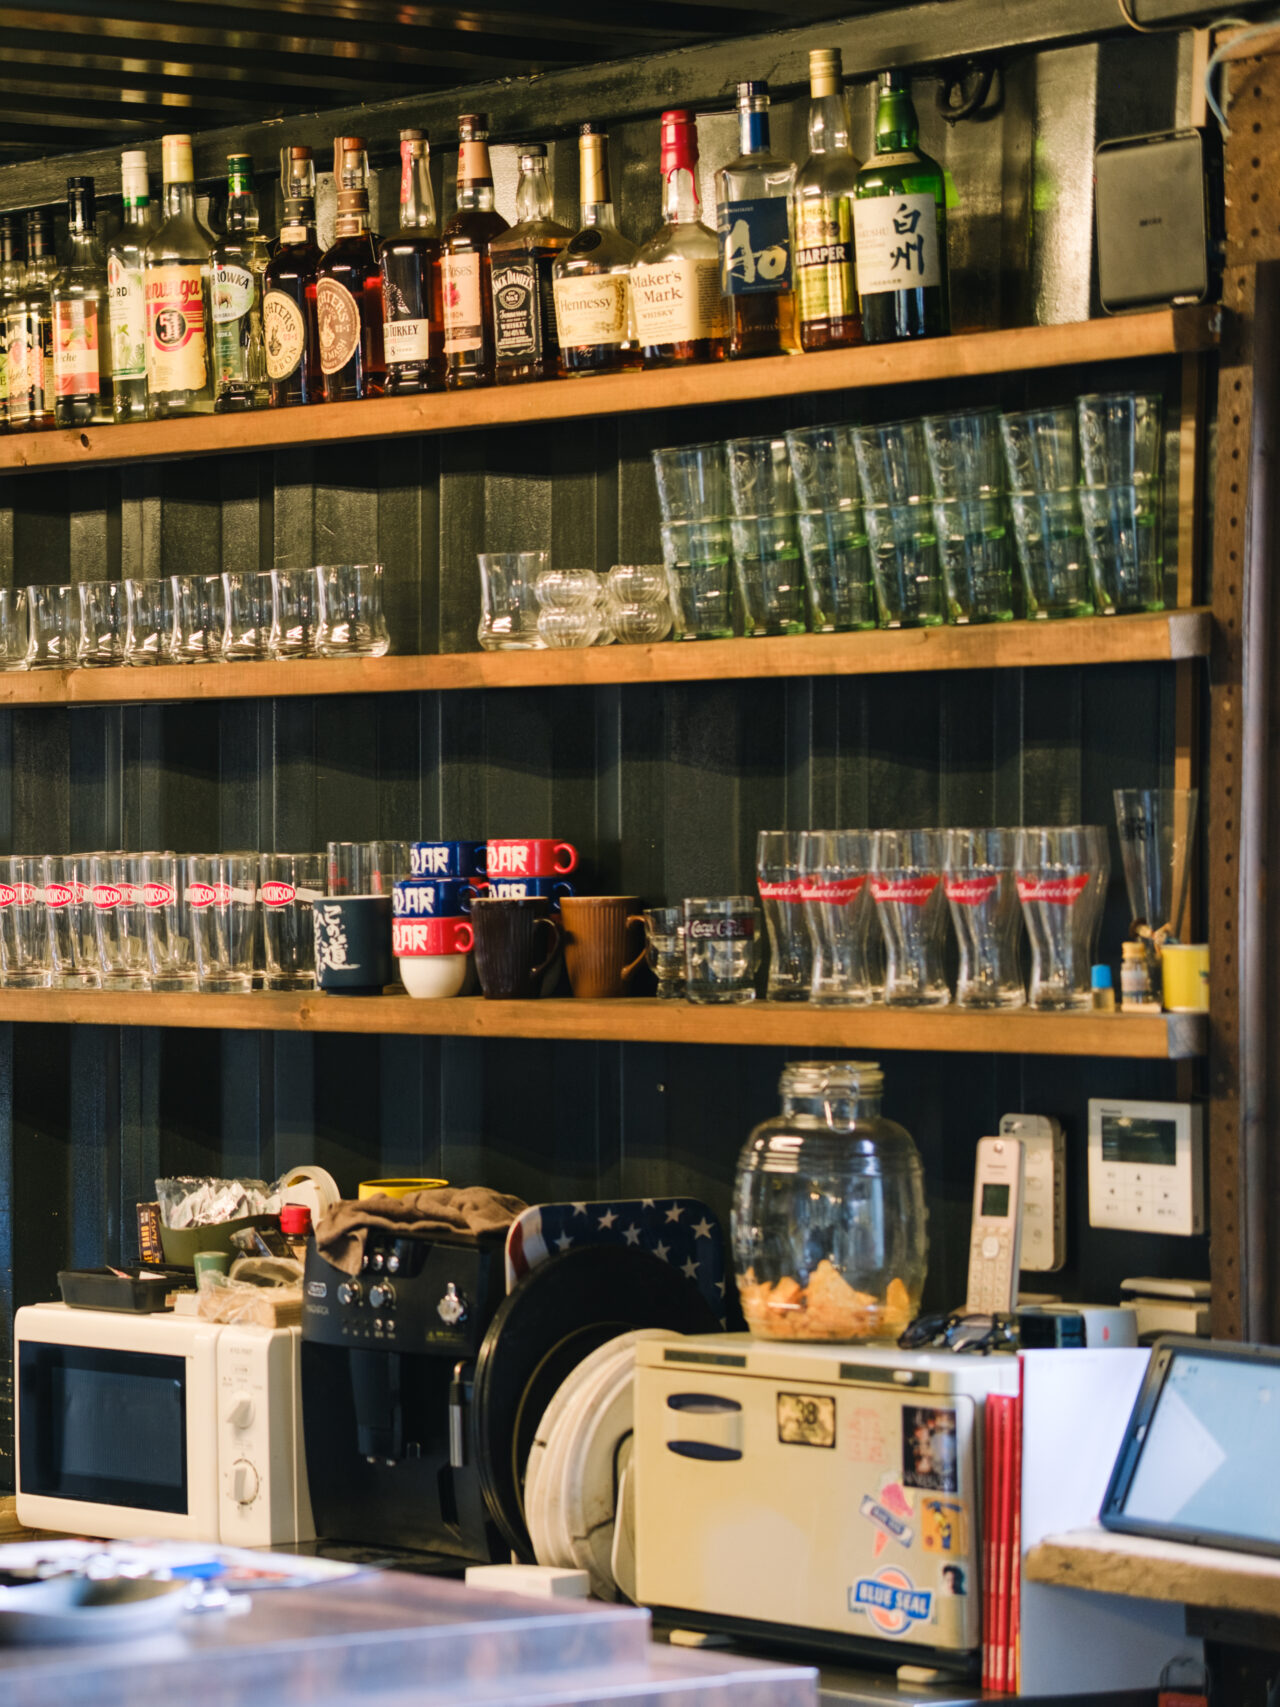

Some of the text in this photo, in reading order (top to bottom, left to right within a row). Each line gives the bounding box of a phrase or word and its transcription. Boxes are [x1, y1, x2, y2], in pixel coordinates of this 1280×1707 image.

[890, 203, 924, 275] 白州
[632, 270, 682, 289] Maker's
[644, 287, 683, 303] Mark
[560, 298, 612, 313] Hennessy
[389, 324, 418, 337] TURKEY
[796, 1400, 819, 1425] 38
[858, 1583, 929, 1617] BLUE SEAL
